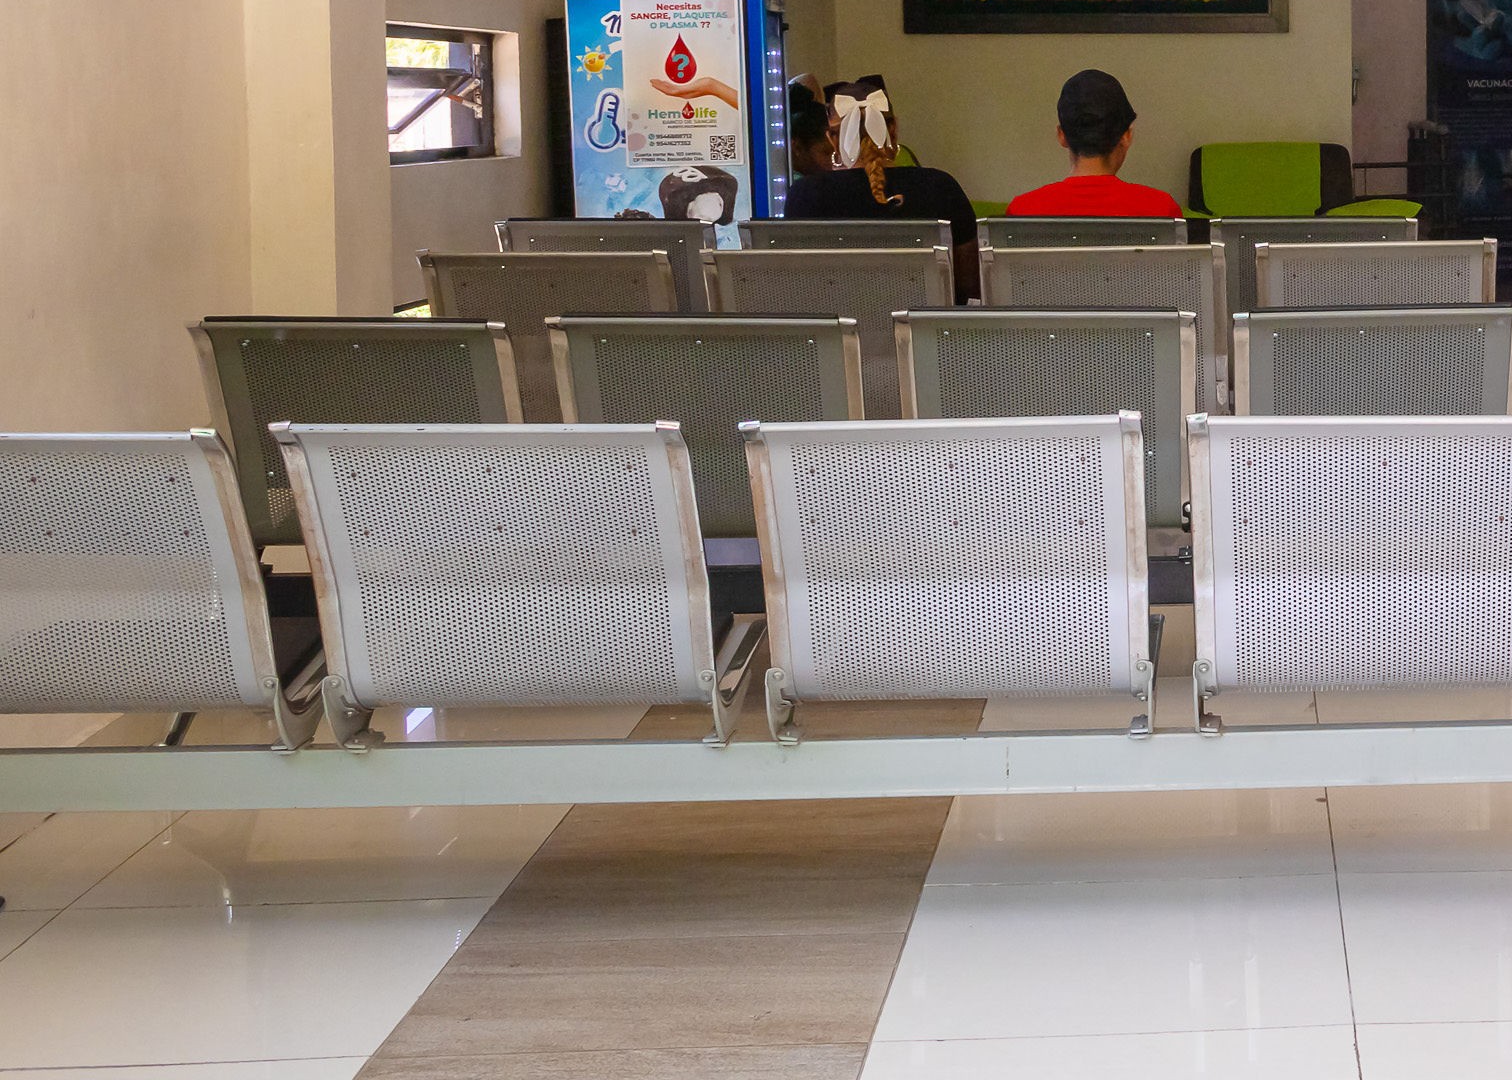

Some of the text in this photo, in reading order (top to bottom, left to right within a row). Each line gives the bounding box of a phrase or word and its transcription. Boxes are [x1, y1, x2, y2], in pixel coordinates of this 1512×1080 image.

[656, 2, 702, 11] Necesitas
[630, 11, 728, 20] SANGRE, PLAQUETAS
[650, 21, 658, 29] O
[660, 21, 698, 29] PLASMA
